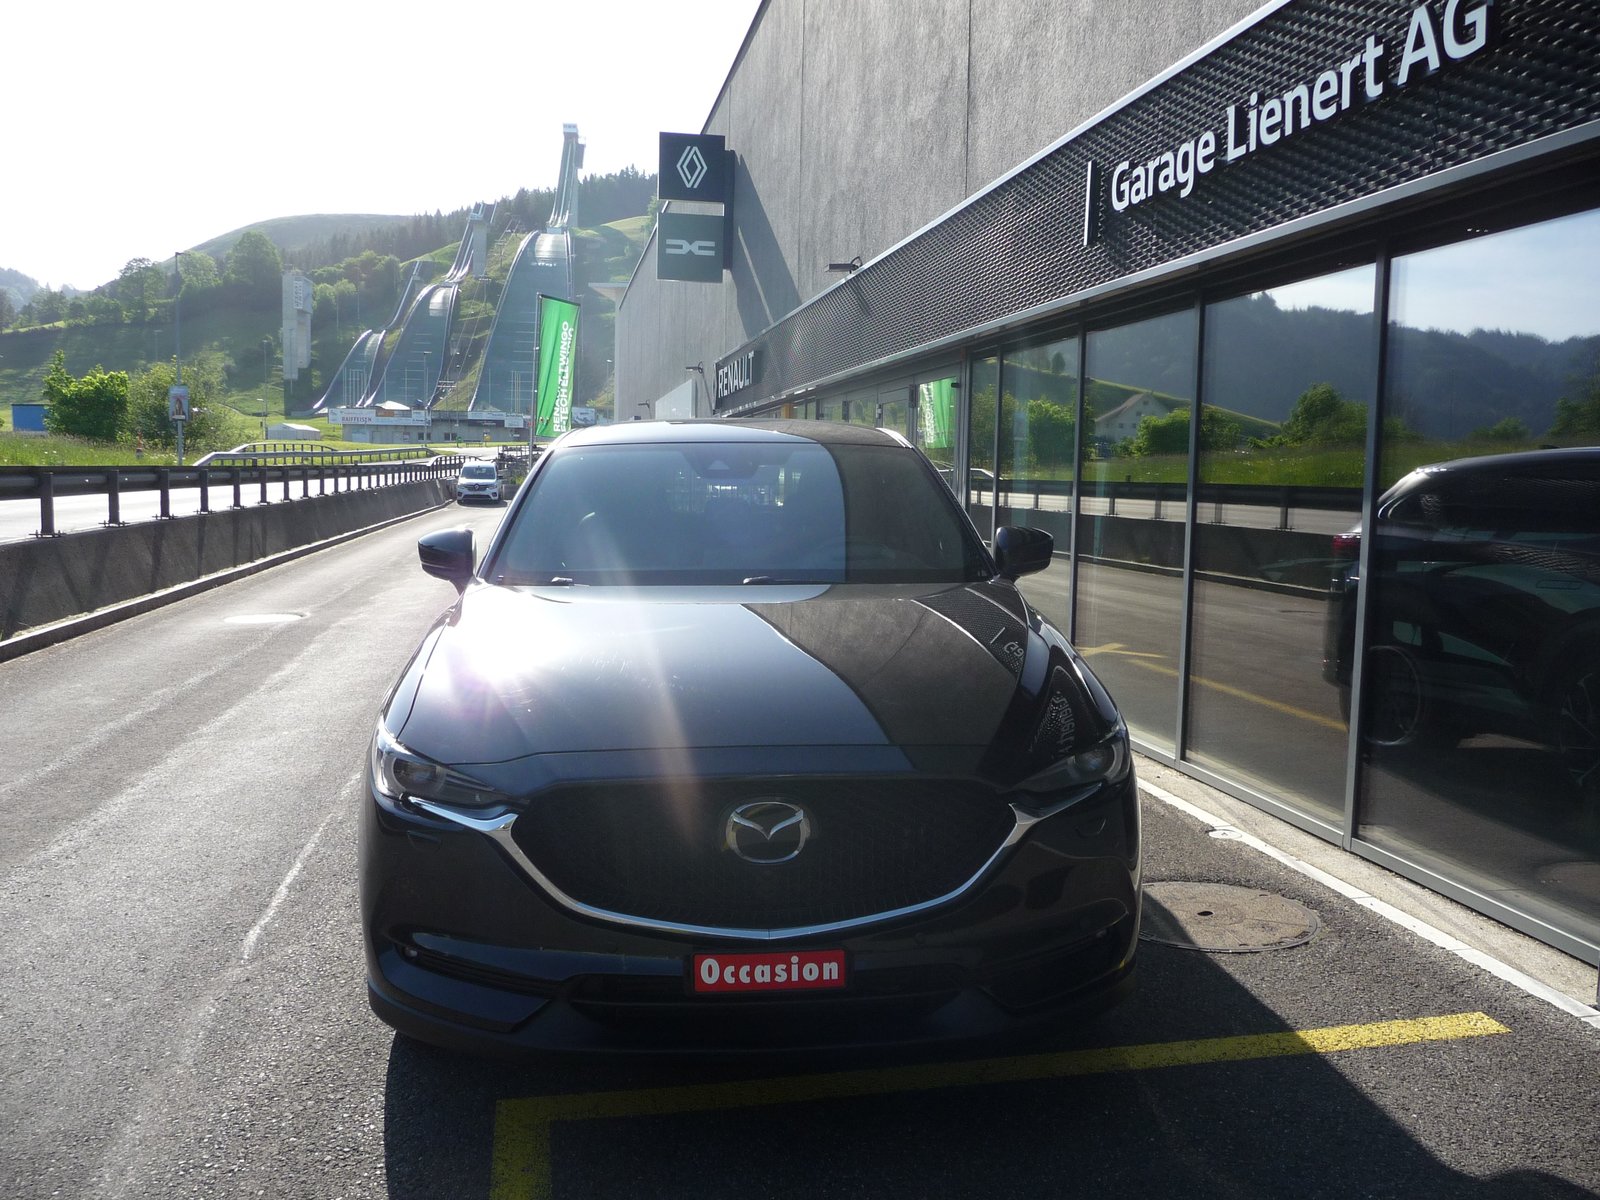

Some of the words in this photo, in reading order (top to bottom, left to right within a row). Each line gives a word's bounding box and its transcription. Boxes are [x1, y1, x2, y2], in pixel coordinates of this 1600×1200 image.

[1111, 130, 1216, 212] Garage
[1226, 34, 1384, 162] Lienert
[1397, 0, 1488, 86] AG
[558, 320, 569, 375] TWINGO
[718, 350, 755, 399] RENAULT
[553, 376, 564, 432] RENAT
[700, 955, 839, 985] Occasion
